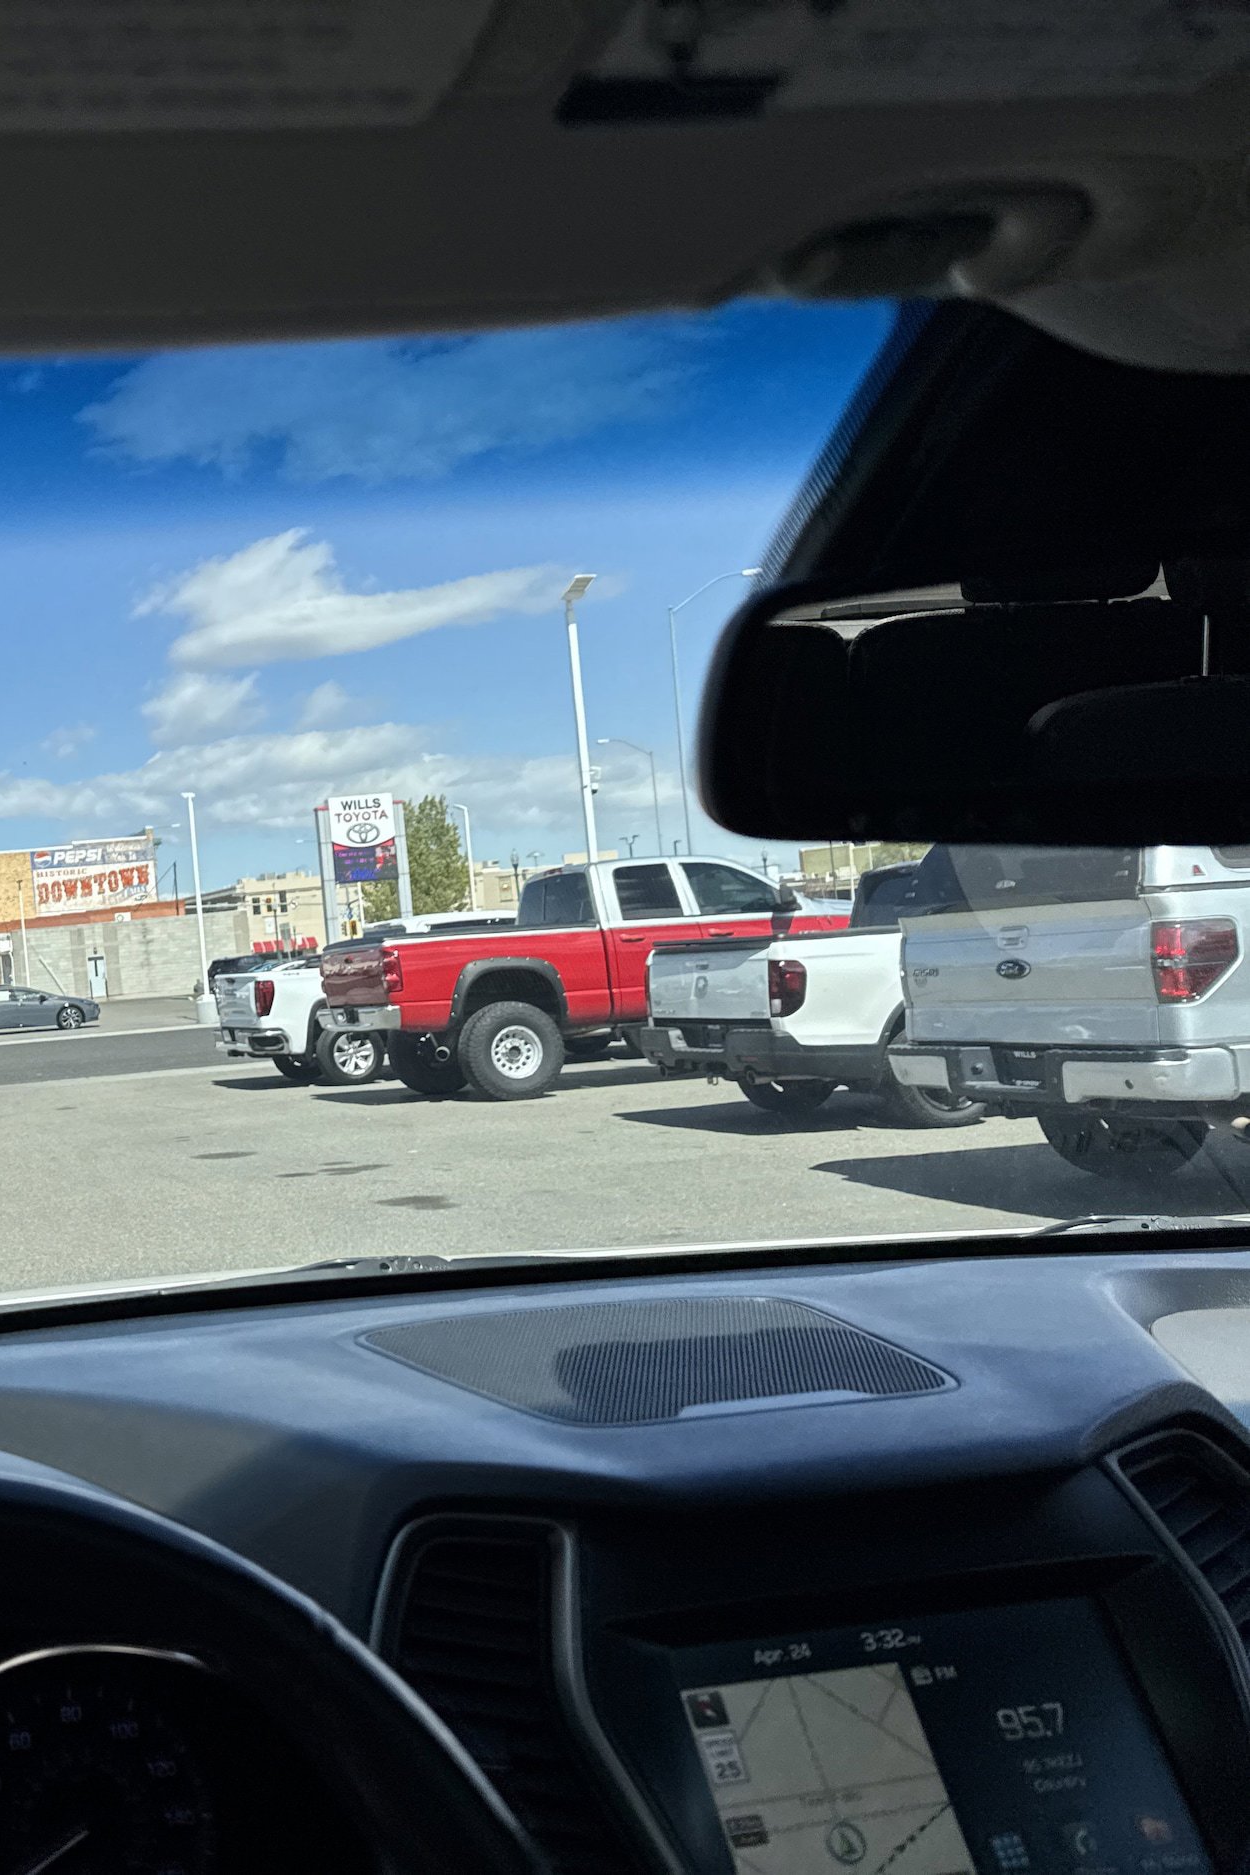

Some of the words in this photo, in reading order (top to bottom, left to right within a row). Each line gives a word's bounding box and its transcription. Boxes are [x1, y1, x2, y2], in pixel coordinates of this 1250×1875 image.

[341, 798, 381, 811] WILLS
[334, 810, 388, 823] TOYOTA
[53, 848, 103, 865] PEPSI
[36, 868, 88, 878] HISTORIC
[36, 864, 149, 906] DOWNTOWN
[1013, 1050, 1037, 1059] WILLS
[861, 1627, 907, 1652] 3:32
[996, 1701, 1064, 1741] 95.7
[715, 1760, 741, 1780] 25
